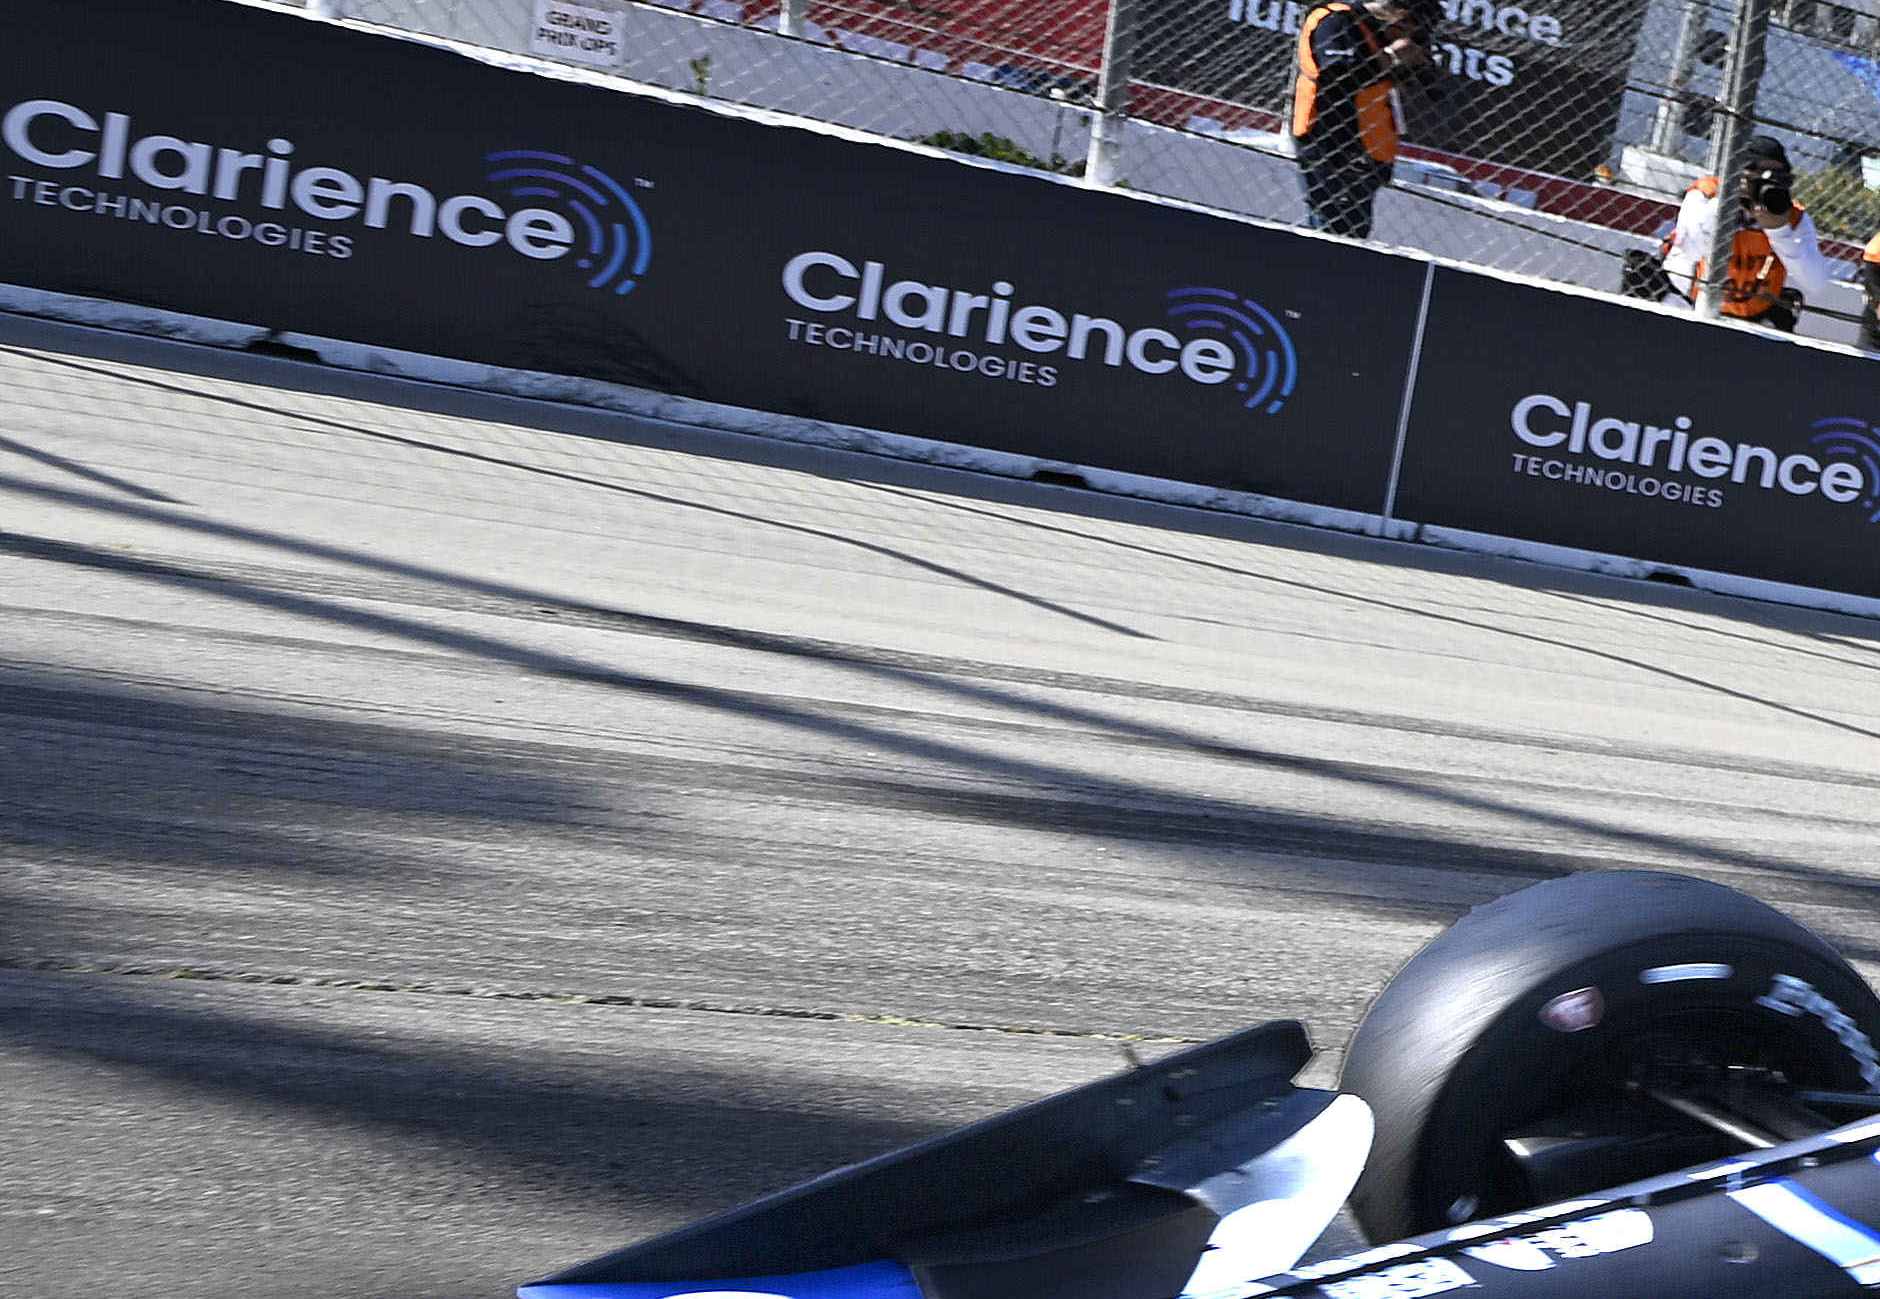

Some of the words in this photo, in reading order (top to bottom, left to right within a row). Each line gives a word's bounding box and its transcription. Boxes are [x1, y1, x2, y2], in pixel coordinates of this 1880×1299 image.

[3, 99, 576, 261] Clarience
[8, 175, 354, 261] TECHNOLOGIES
[782, 250, 1237, 387] Clarience
[786, 317, 1059, 388] TECHNOLOGIES
[1511, 393, 1864, 506] Clarience
[1512, 452, 1723, 510] TECHNOLOGIES
